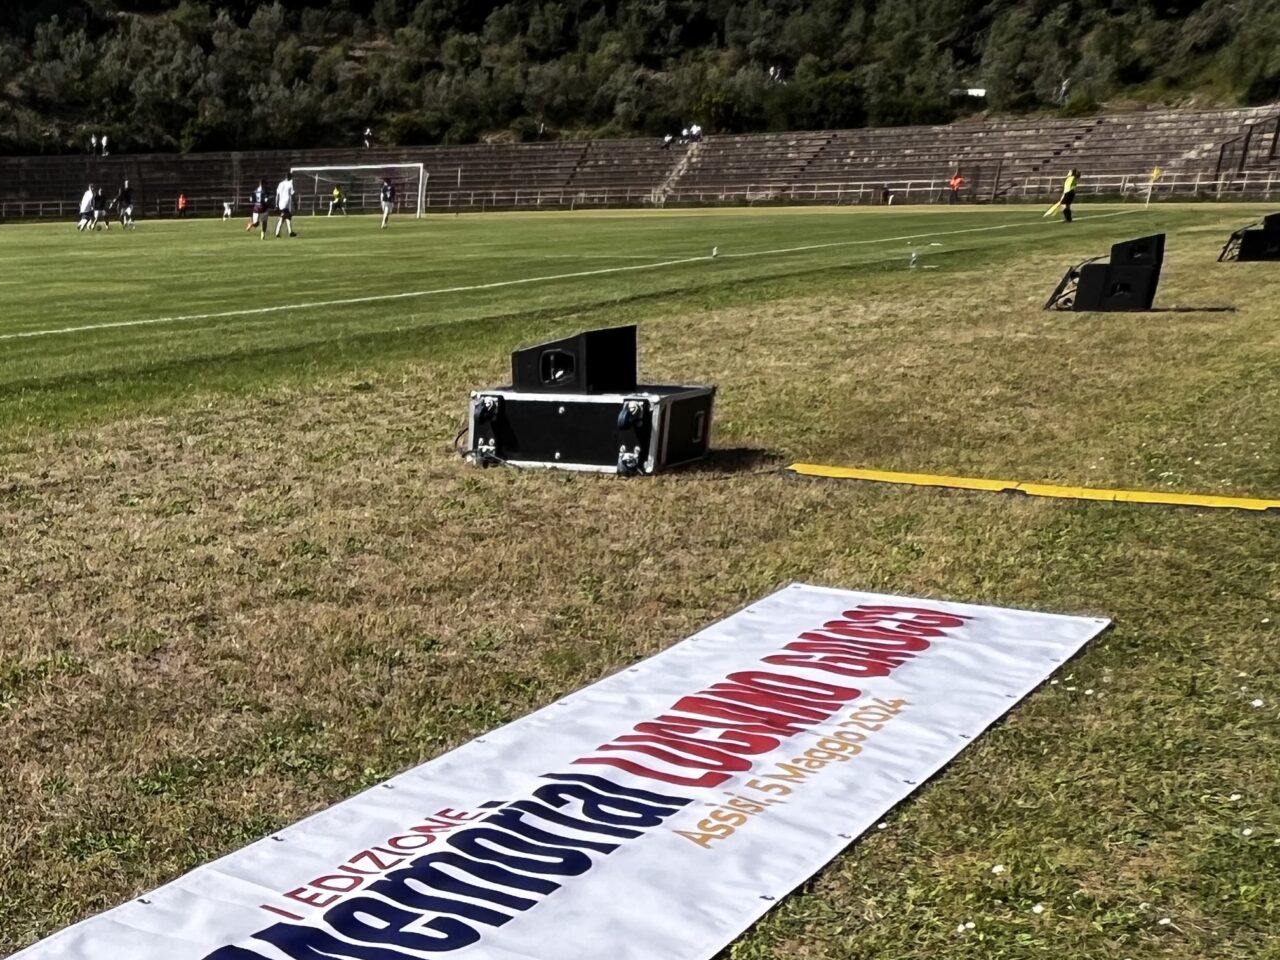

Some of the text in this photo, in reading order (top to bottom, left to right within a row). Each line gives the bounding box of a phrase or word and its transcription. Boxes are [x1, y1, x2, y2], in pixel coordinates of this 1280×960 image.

[569, 670, 862, 788] LUCIANO
[760, 604, 975, 678] GAUCCI
[761, 729, 867, 784] Maggio
[840, 697, 913, 732] 2024
[283, 808, 488, 908] EDIZIONE
